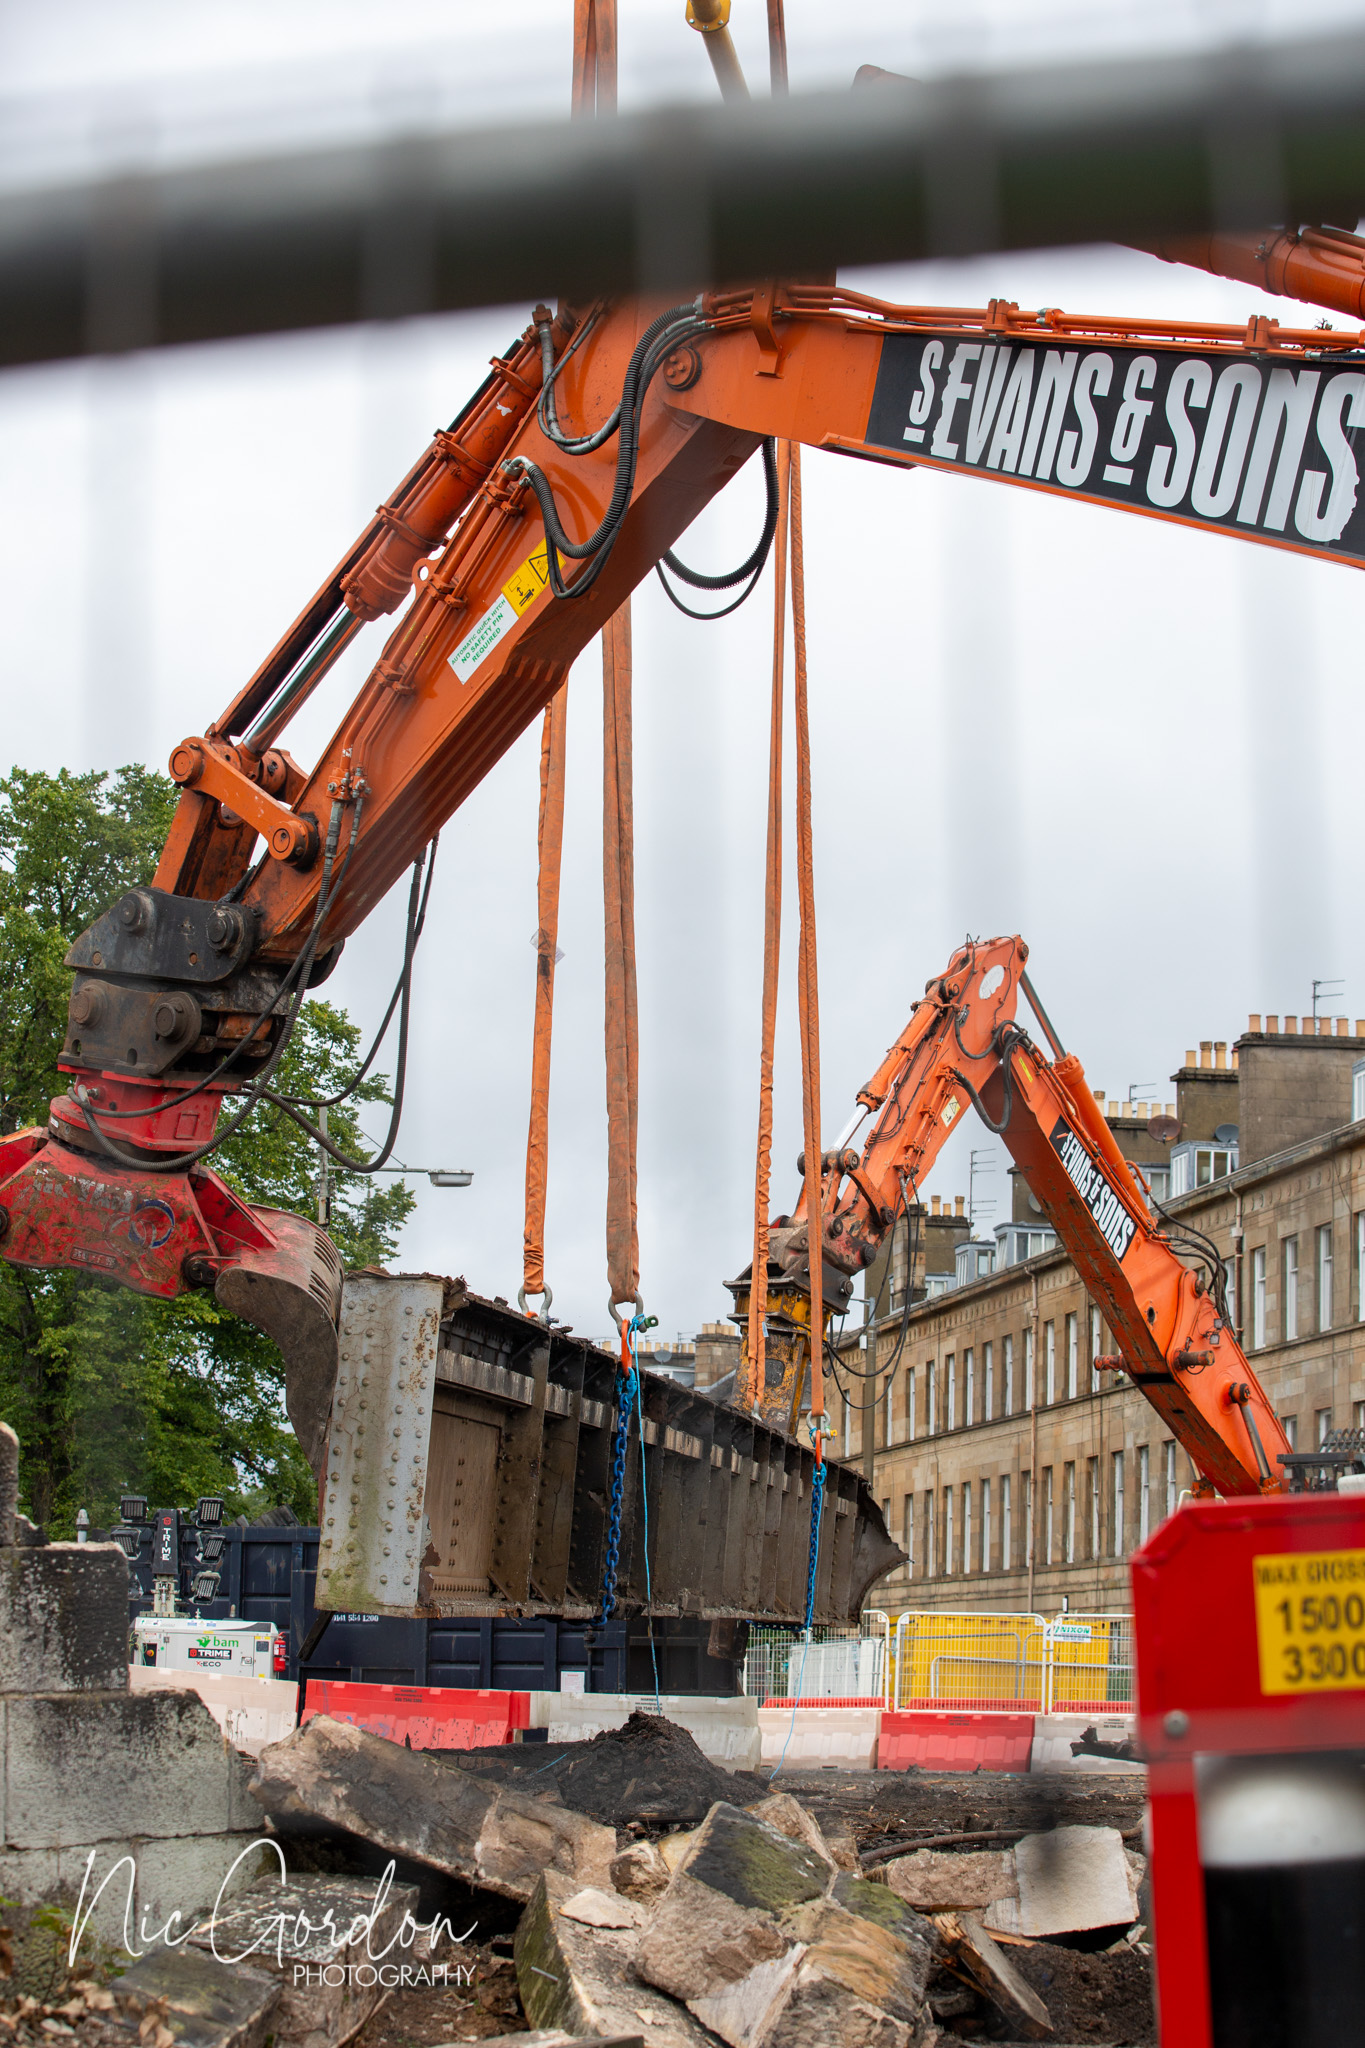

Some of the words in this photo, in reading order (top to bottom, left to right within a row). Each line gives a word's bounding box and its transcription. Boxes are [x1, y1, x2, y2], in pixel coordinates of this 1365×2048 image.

[930, 342, 1114, 487] EVANS
[1102, 355, 1157, 485] &
[1146, 359, 1365, 543] SONS
[451, 633, 477, 665] AUTOMATIC
[476, 616, 492, 635] QUICK
[491, 599, 506, 617] HITCH
[461, 651, 471, 664] NO
[470, 626, 493, 653] SAFETY
[492, 612, 504, 627] PIN
[472, 627, 501, 663] REQUIRED
[1062, 1137, 1096, 1198] EVANS
[1092, 1184, 1135, 1258] SONS
[161, 1527, 172, 1561] TRIME
[197, 1649, 230, 1657] TRIME
[213, 1636, 239, 1648] bam
